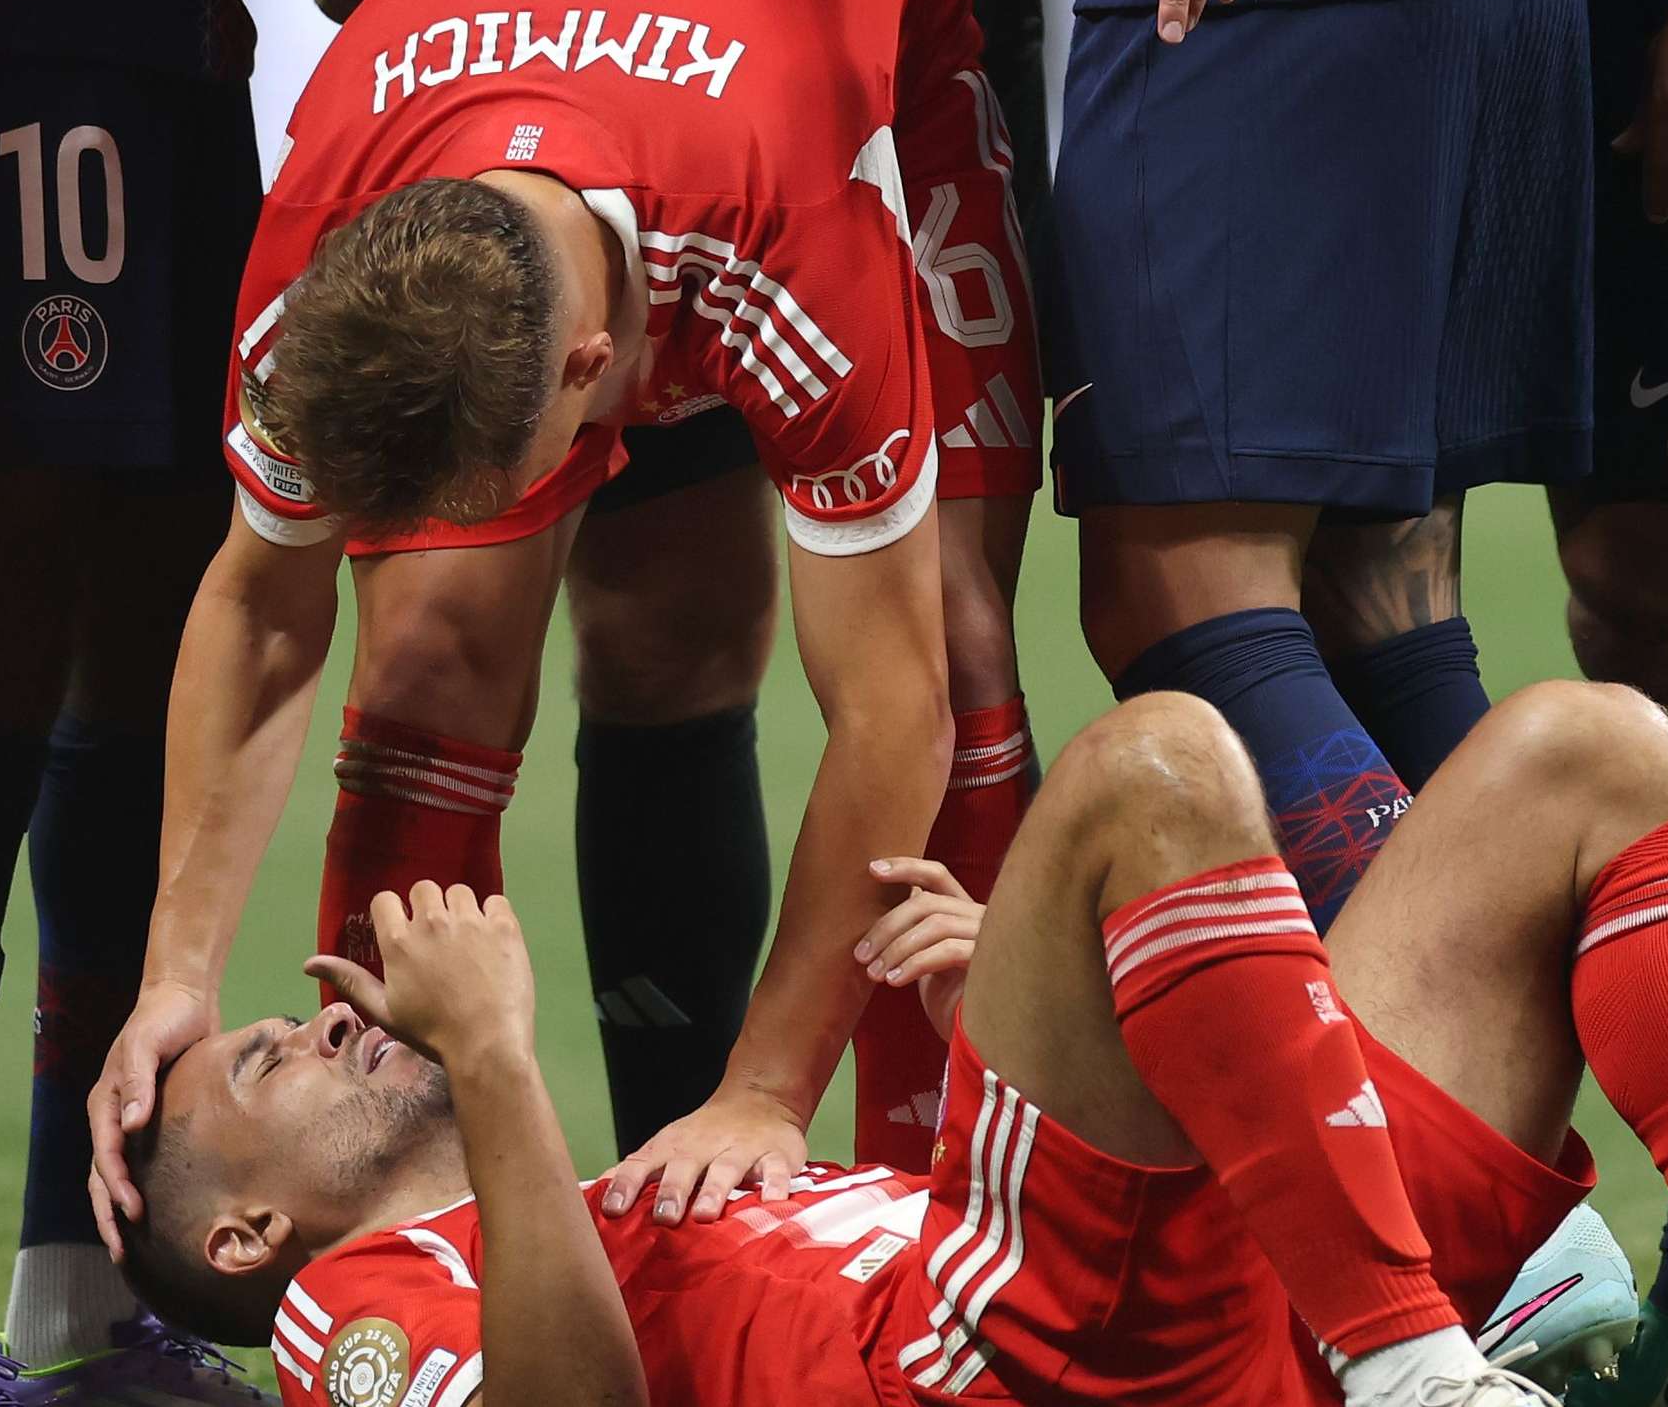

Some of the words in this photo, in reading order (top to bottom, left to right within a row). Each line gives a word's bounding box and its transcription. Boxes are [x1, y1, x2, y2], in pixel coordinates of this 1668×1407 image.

[373, 9, 746, 115] KIMMICH
[0, 122, 126, 284] 10
[913, 182, 1014, 348] 6
[35, 299, 93, 323] PARIS
[276, 479, 301, 494] FIFA
[337, 1331, 363, 1357] CUP
[365, 1328, 382, 1341] 25
[381, 1334, 401, 1362] USA
[412, 1359, 439, 1398] UNITES
